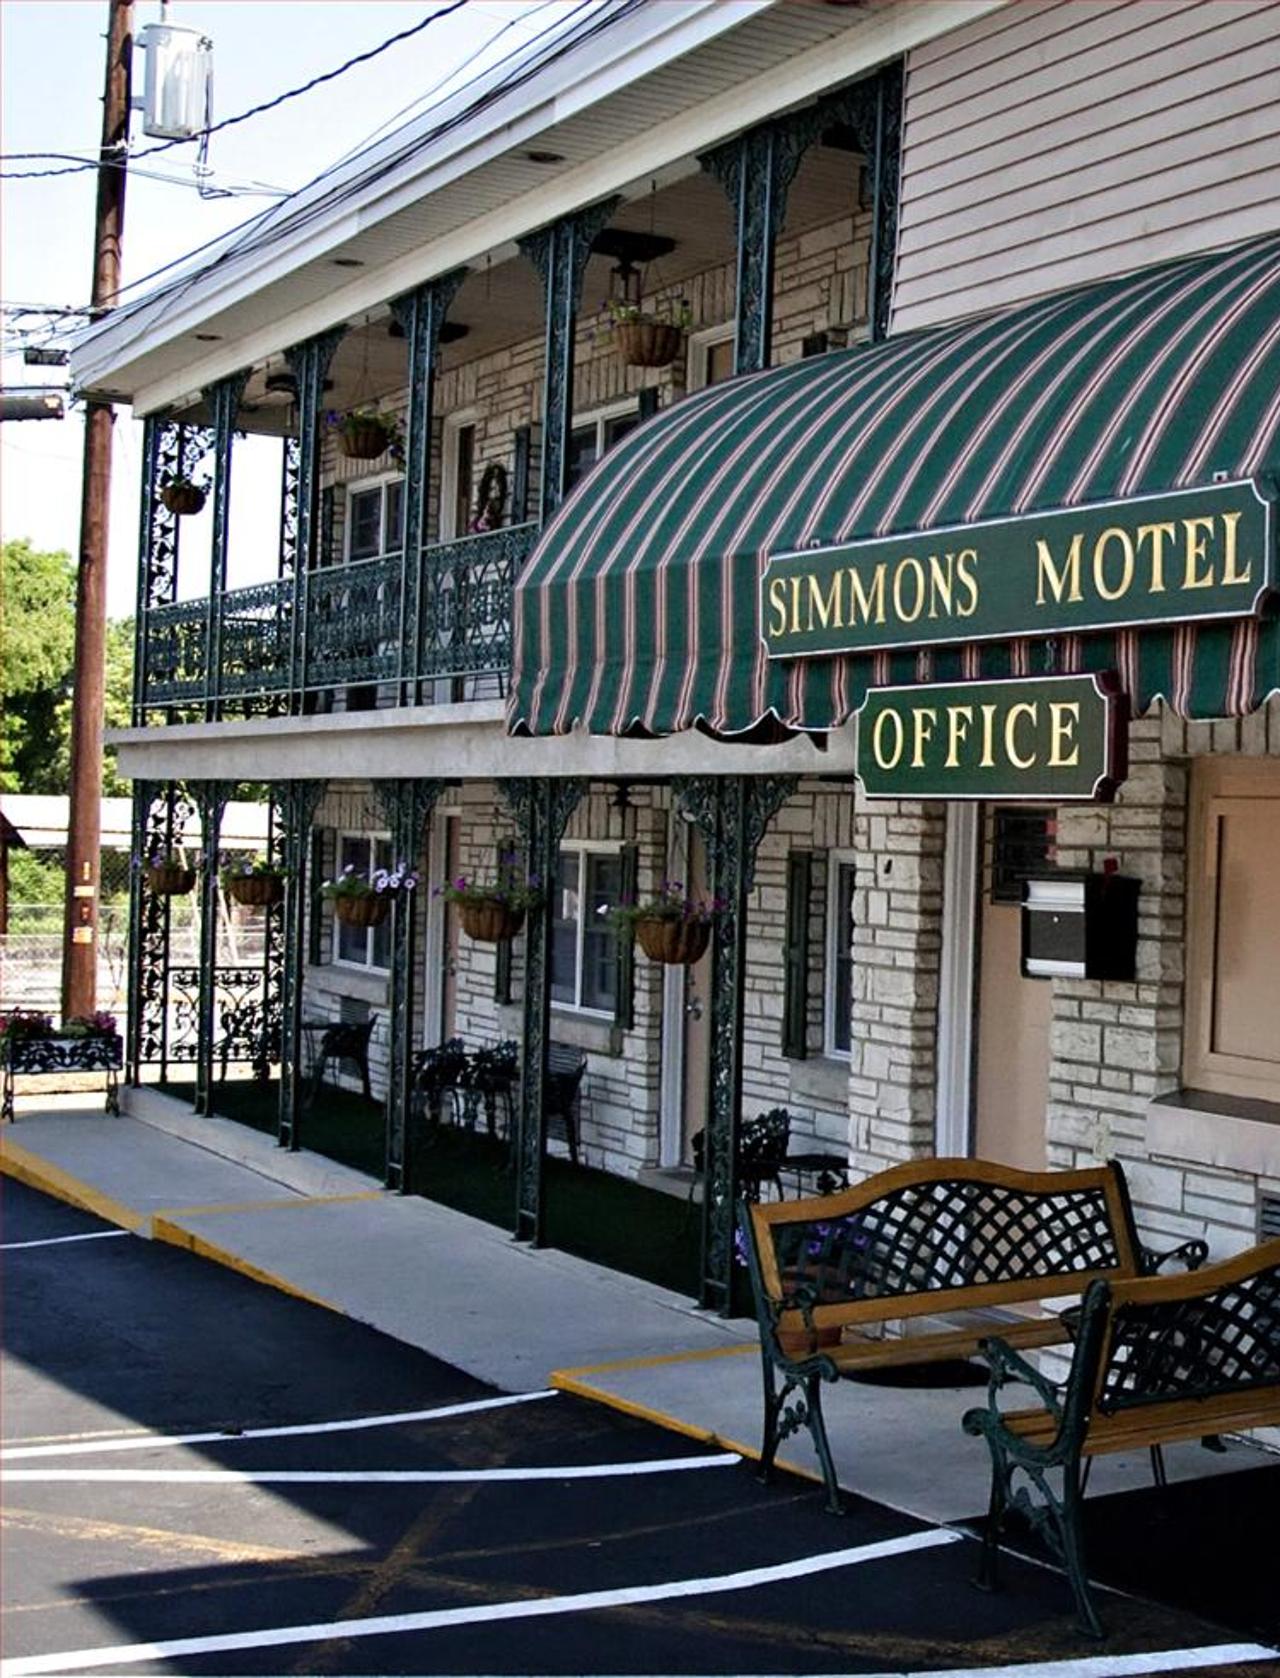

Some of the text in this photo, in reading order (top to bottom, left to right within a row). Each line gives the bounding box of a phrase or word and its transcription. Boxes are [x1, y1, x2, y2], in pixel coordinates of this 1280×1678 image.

[769, 511, 1252, 637] SIMMONS MOTEL
[872, 701, 1081, 770] OFFICE
